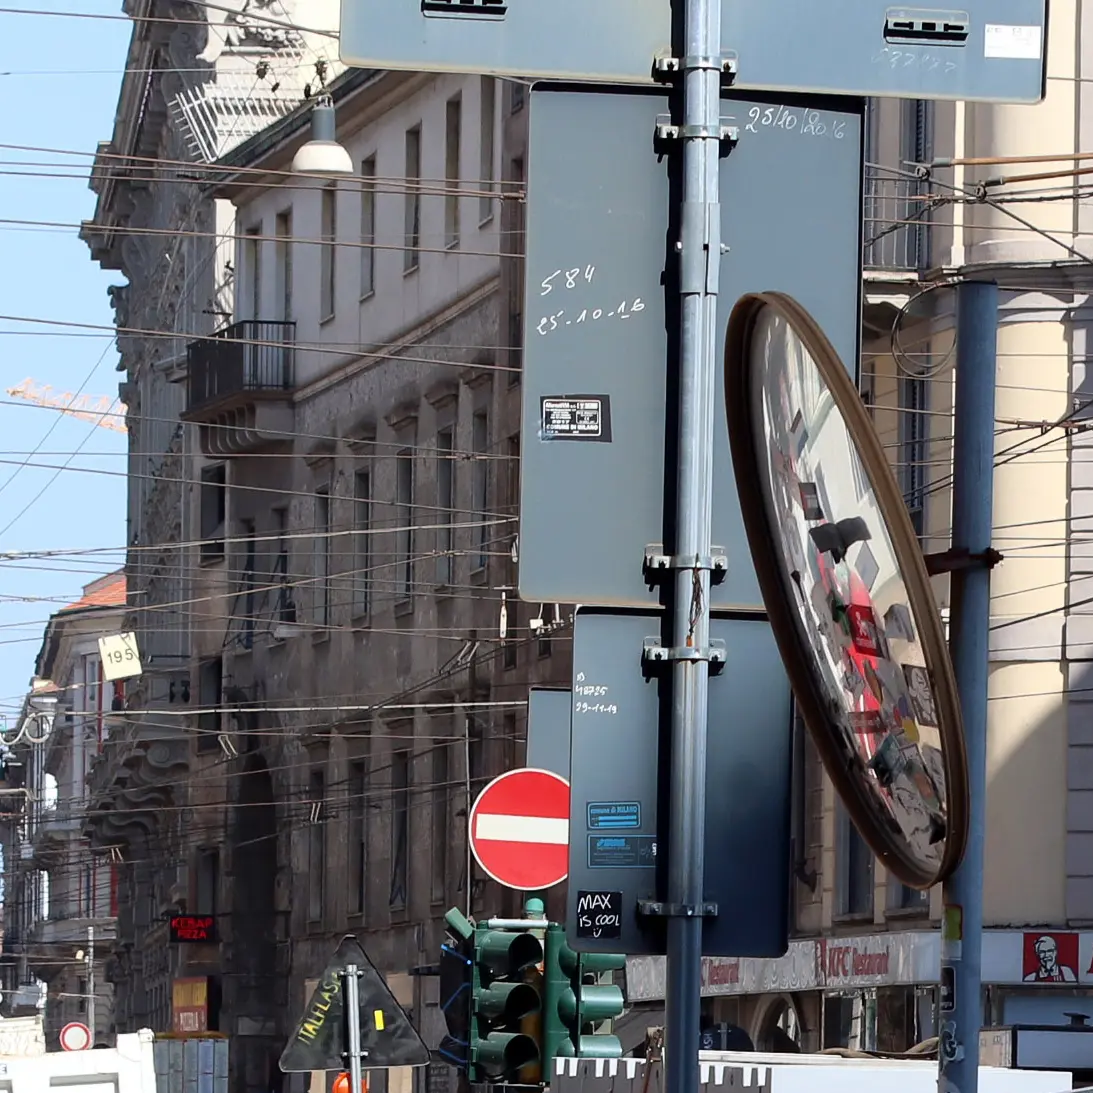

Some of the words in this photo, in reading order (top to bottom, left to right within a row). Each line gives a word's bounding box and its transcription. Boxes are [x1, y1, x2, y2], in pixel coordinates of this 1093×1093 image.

[107, 648, 133, 664] 195
[577, 893, 612, 914] MAX
[594, 914, 620, 927] COOL
